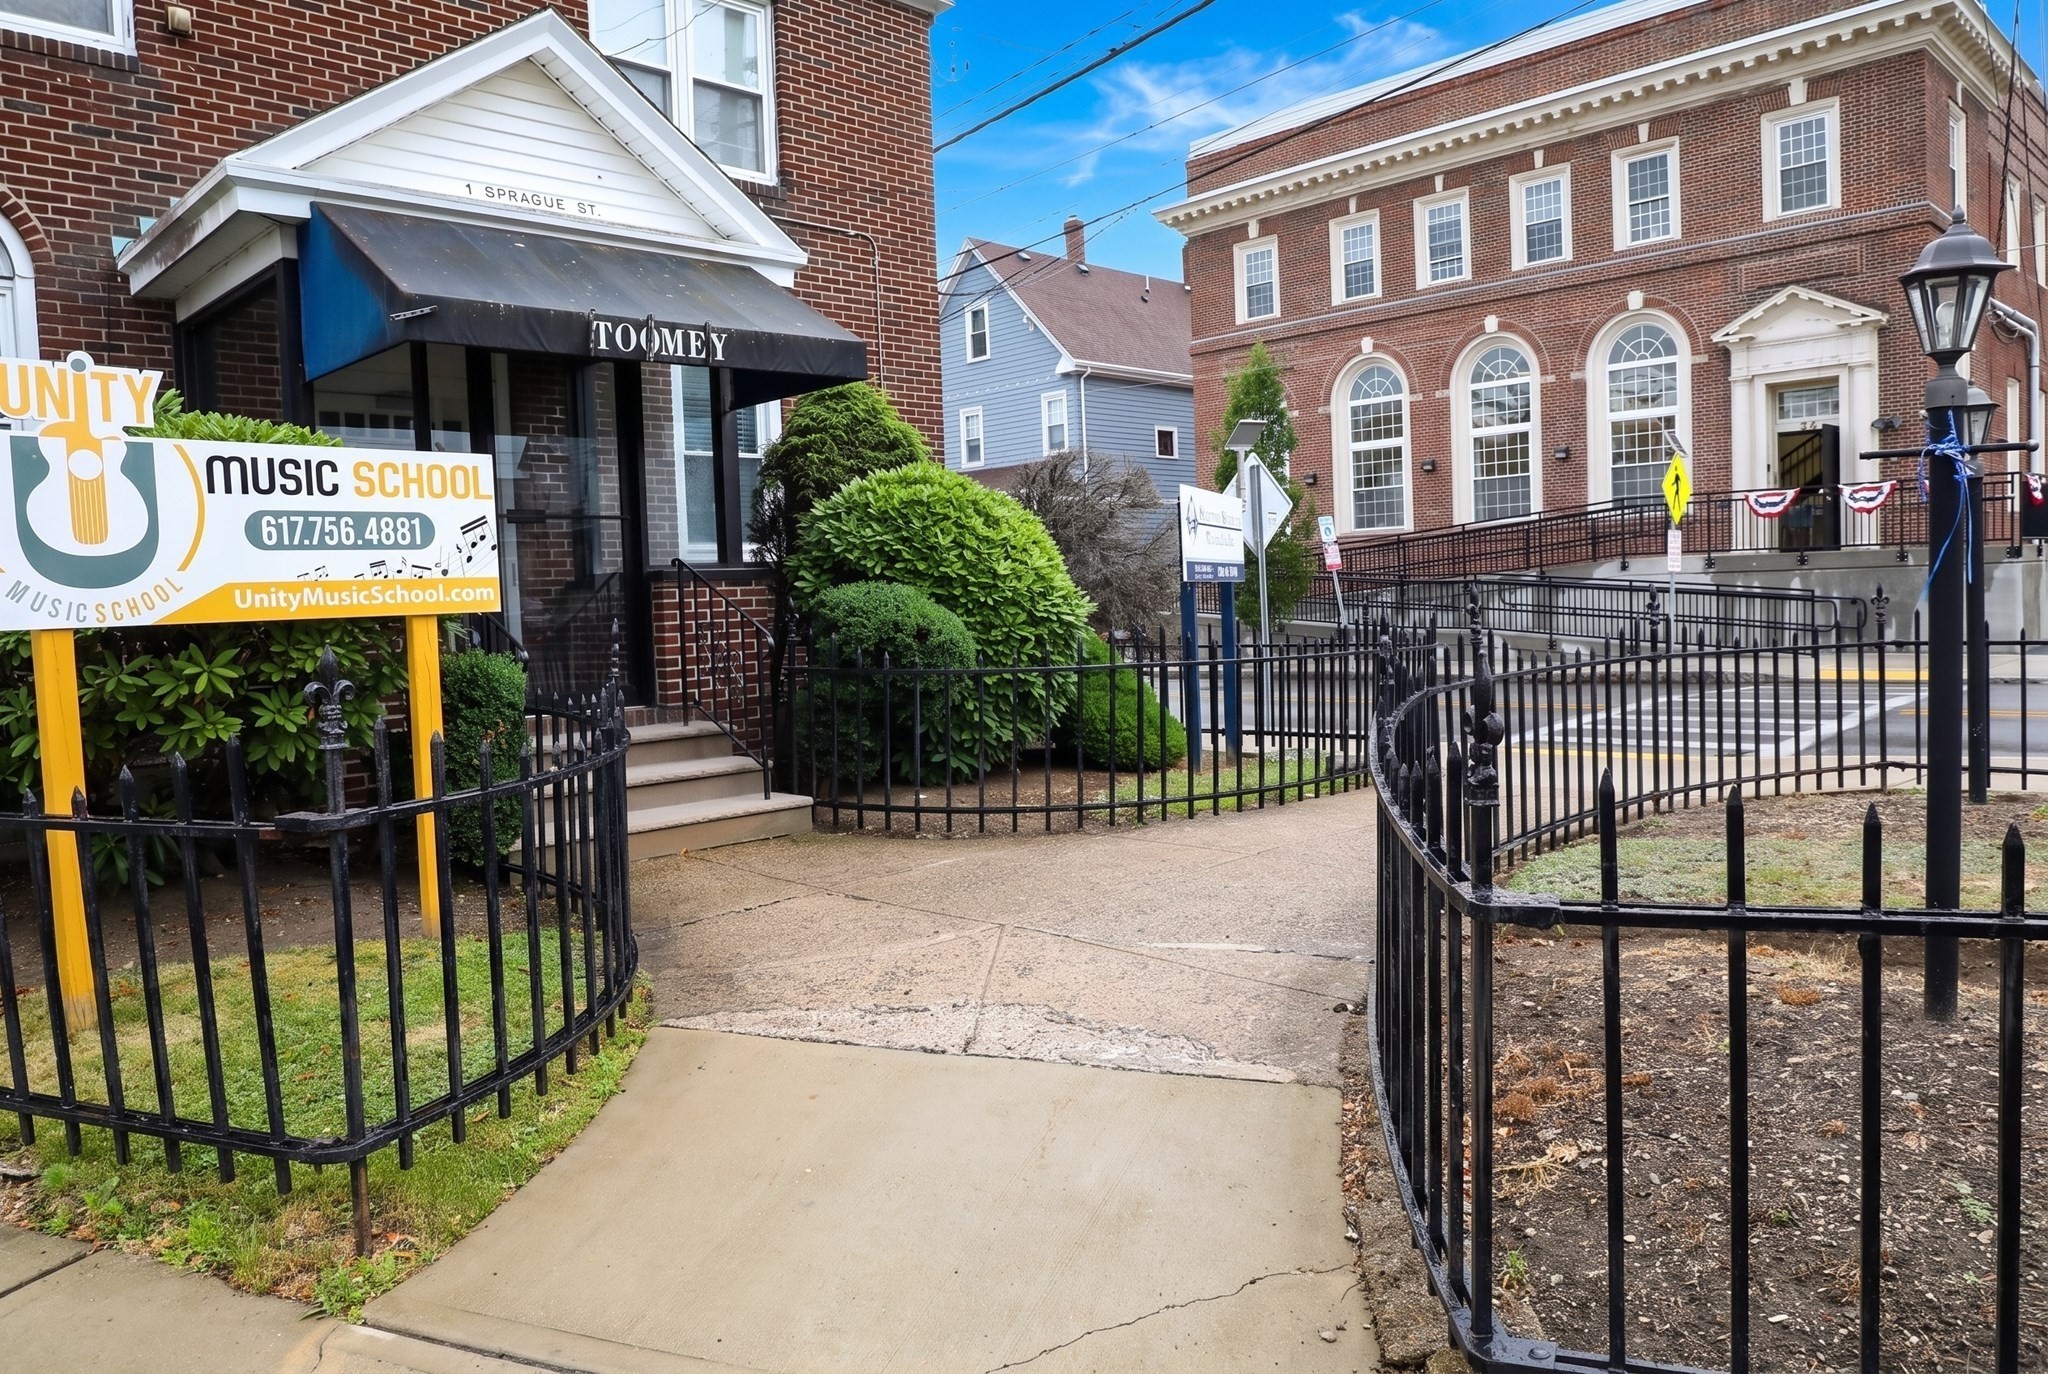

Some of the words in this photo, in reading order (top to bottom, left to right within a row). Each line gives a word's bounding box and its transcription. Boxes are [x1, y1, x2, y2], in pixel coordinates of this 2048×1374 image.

[465, 183, 473, 196] 1
[485, 186, 565, 211] SPRAGUE
[577, 202, 601, 217] ST.
[592, 320, 728, 361] TOOMEY
[205, 455, 340, 496] MUSIC
[353, 461, 493, 500] SCHOOL
[261, 515, 422, 546] 617.756.4881
[5, 580, 88, 623] MUSIC
[95, 577, 184, 624] SCHOOL
[234, 585, 495, 612] UnityMusicSchool.com
